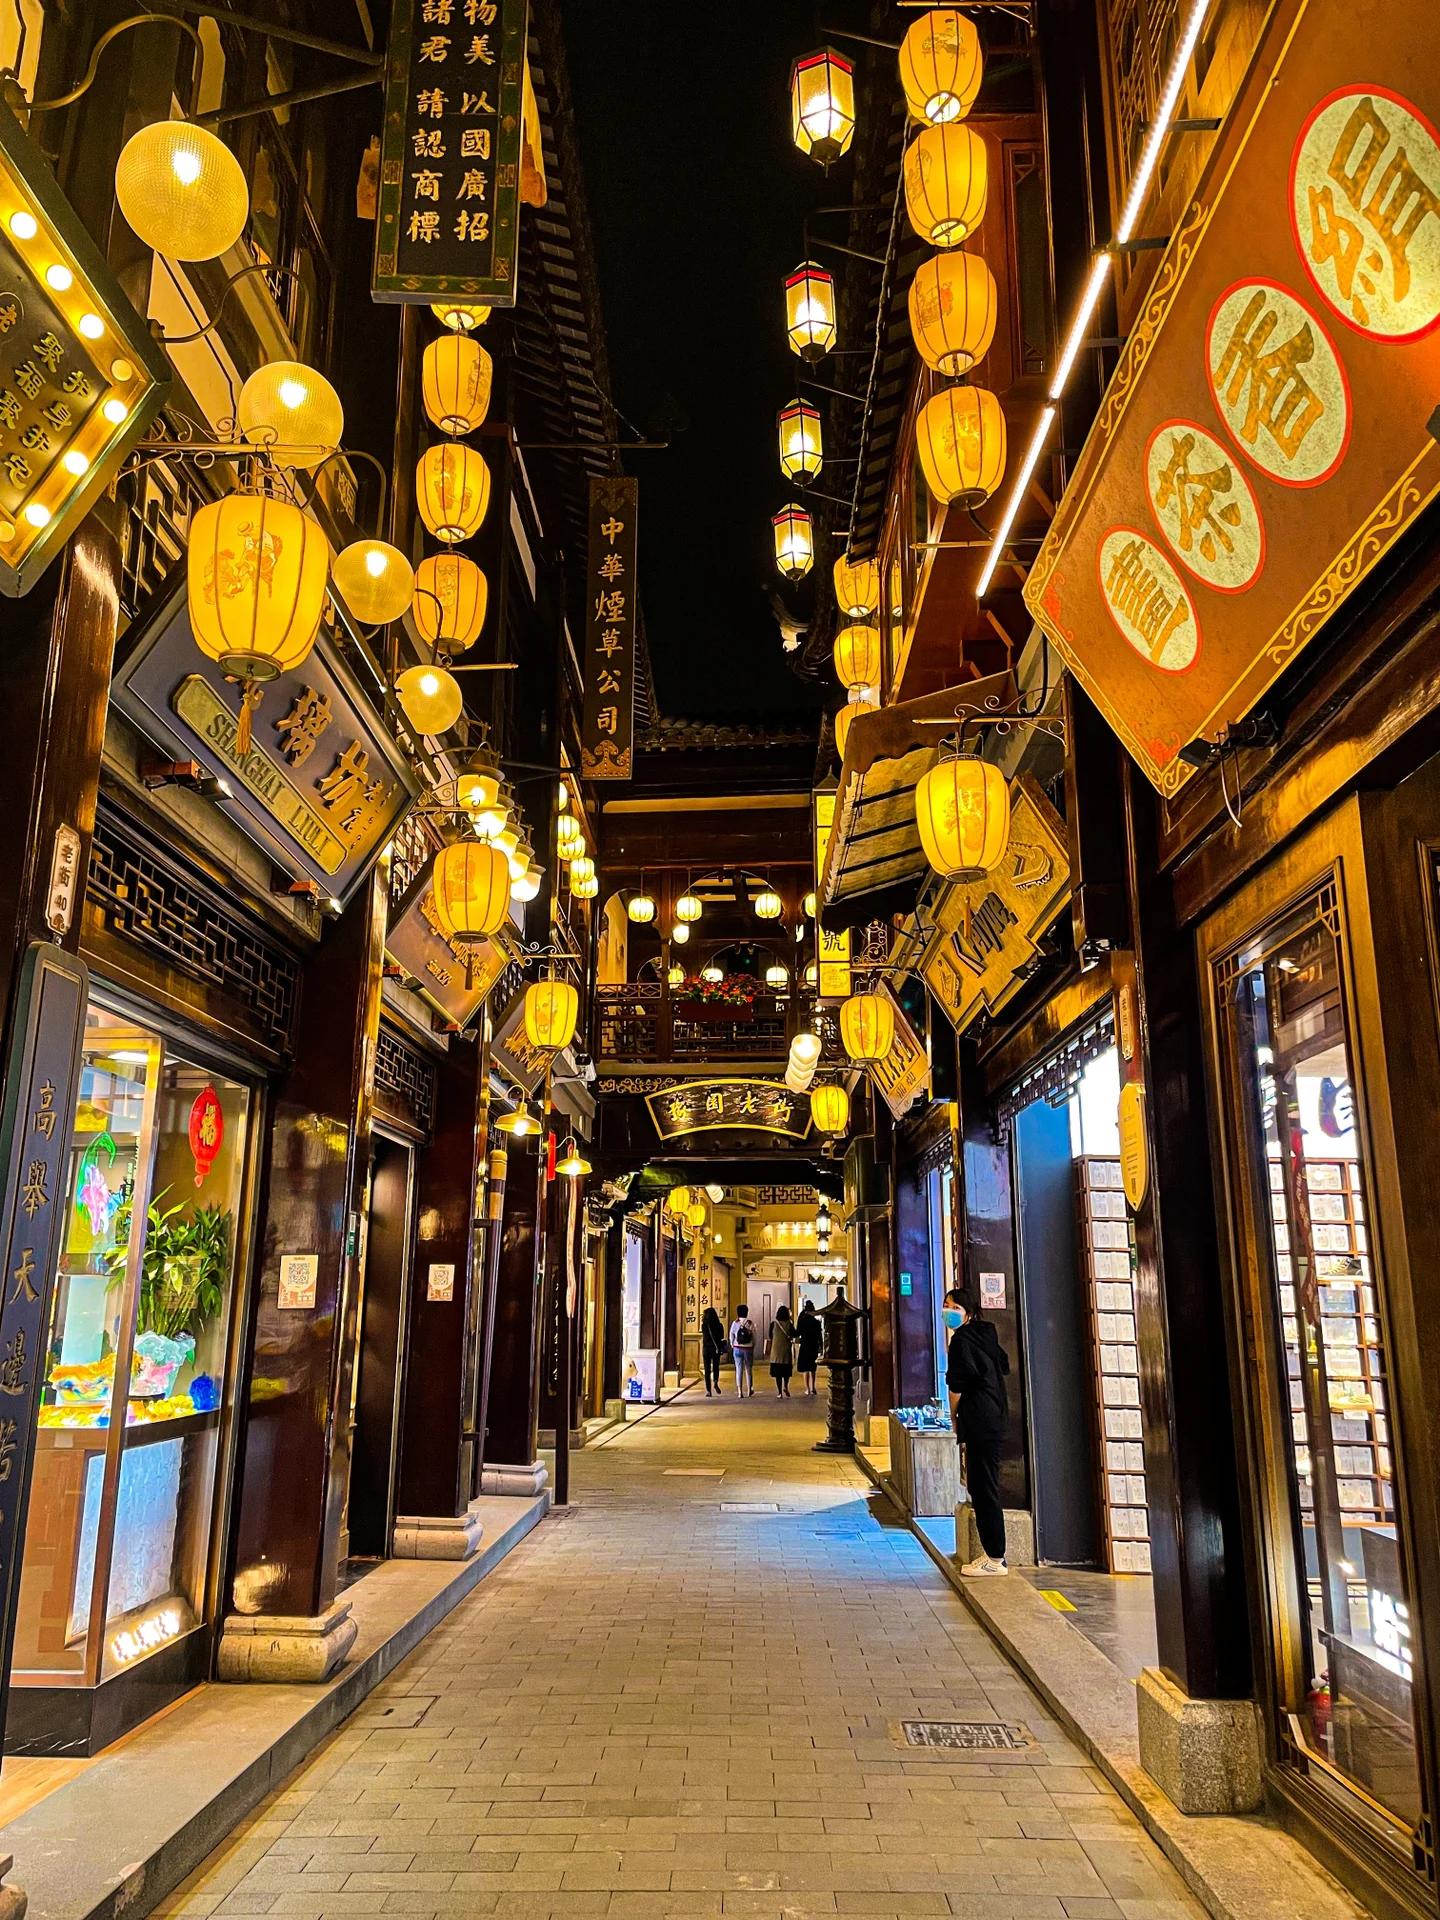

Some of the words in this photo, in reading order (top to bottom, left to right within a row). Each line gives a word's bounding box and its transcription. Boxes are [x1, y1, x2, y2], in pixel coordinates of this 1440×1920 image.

[594, 516, 626, 735] 中華煙草公司
[288, 805, 332, 857] LIULI
